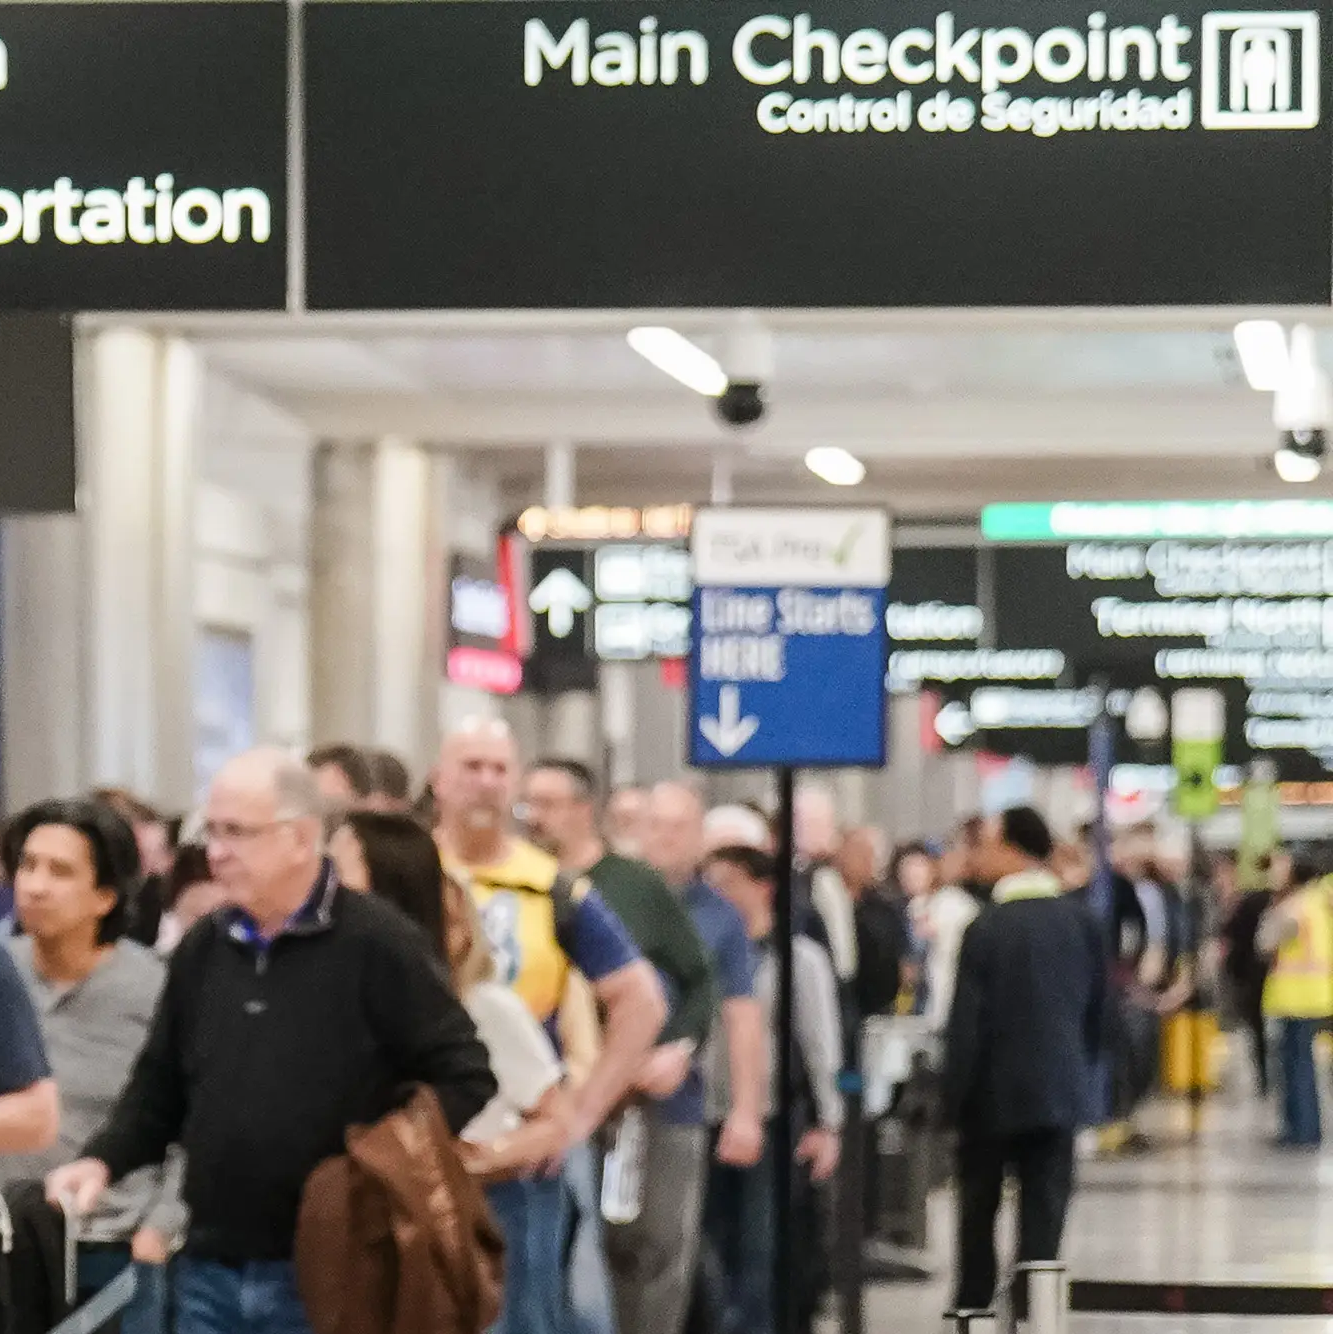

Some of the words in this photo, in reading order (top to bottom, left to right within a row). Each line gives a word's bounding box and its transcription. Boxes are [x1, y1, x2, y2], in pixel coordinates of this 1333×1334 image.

[523, 18, 709, 87] Main
[732, 11, 1193, 92] Checkpoint
[756, 90, 913, 134] Control
[917, 90, 975, 134] de
[980, 88, 1193, 137] Seguridad
